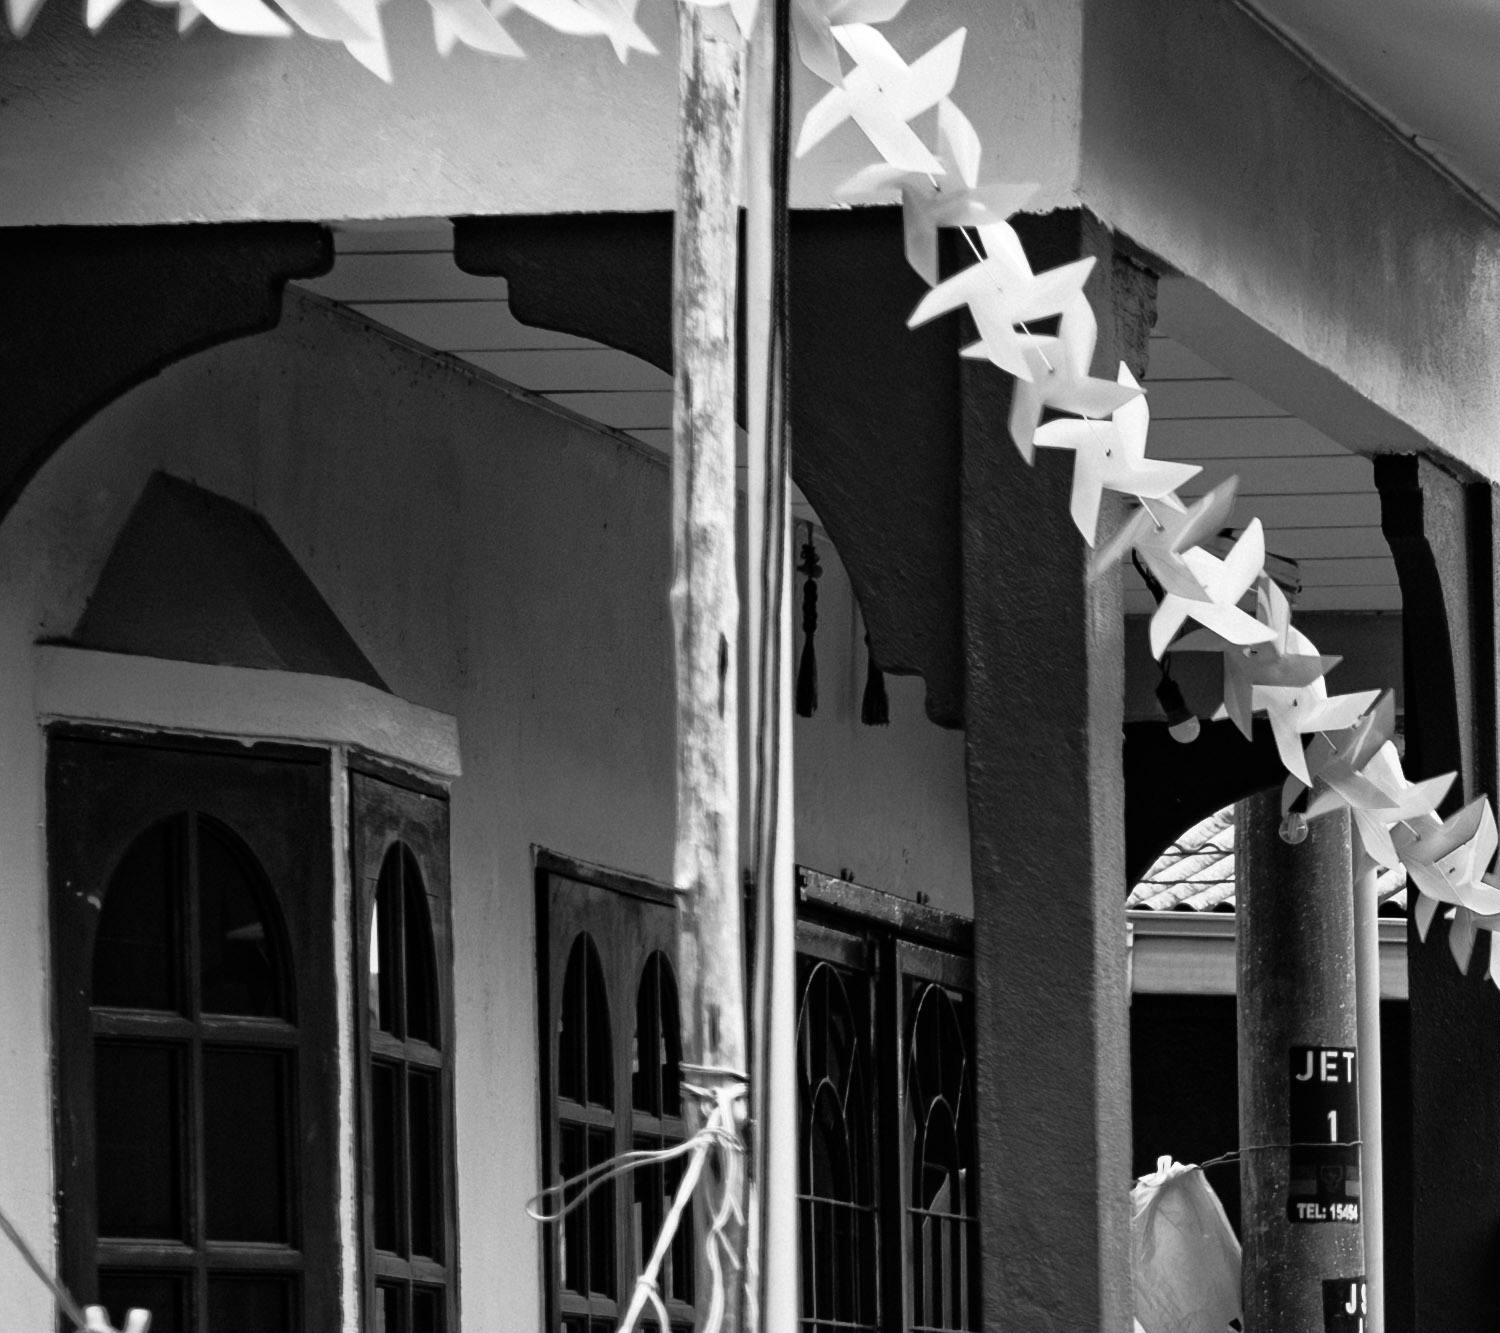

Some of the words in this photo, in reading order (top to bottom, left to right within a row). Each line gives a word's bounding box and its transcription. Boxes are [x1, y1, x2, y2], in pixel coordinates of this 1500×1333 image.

[1296, 1050, 1355, 1083] JET
[1326, 1110, 1338, 1143] 1
[1296, 1202, 1327, 1219] TEL:
